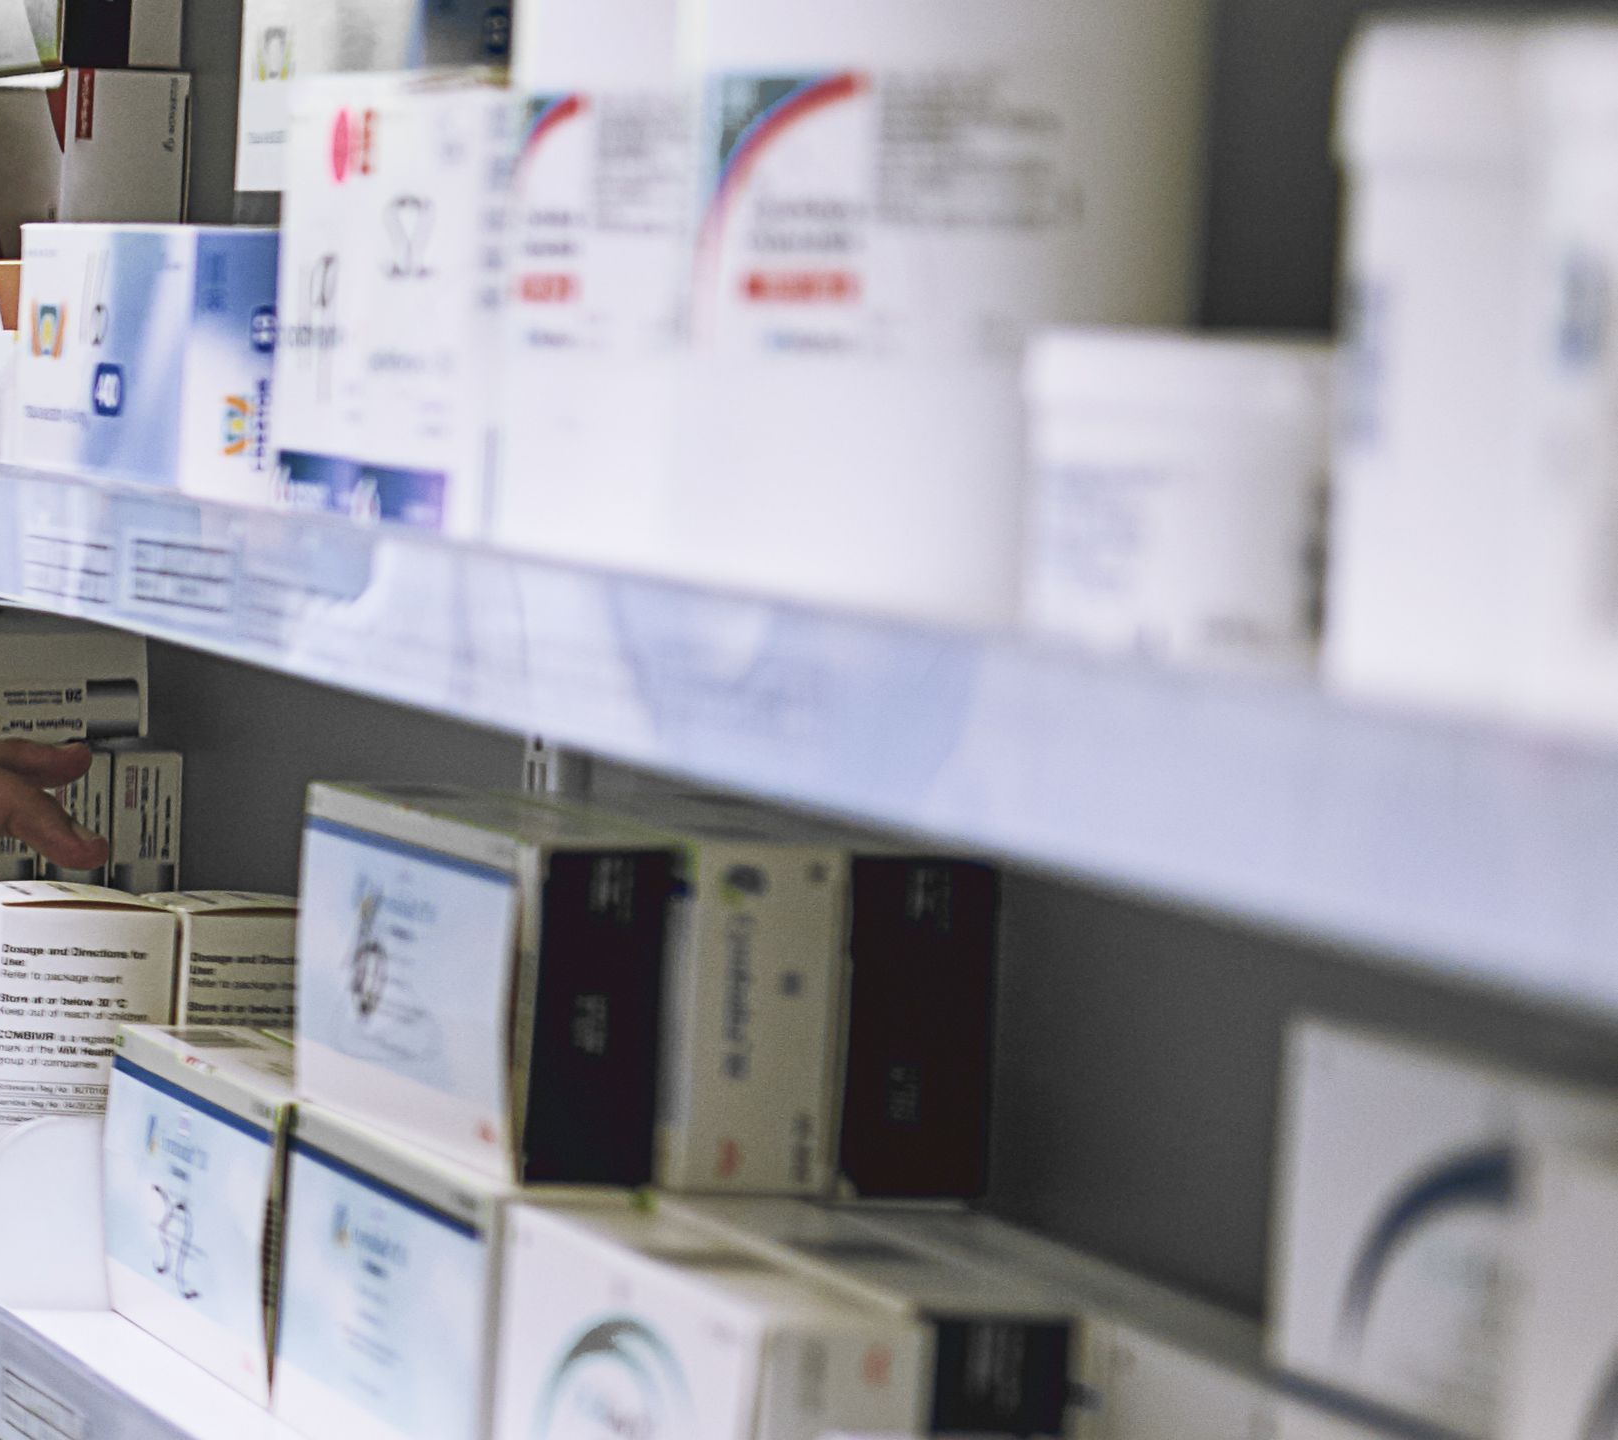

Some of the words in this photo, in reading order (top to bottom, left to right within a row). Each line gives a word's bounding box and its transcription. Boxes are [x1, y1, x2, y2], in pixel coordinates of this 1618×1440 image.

[1, 944, 44, 959] Dosage
[48, 945, 68, 957] and
[71, 946, 128, 960] Directions
[32, 995, 41, 1005] at
[60, 996, 95, 1008] below
[28, 1008, 45, 1018] out
